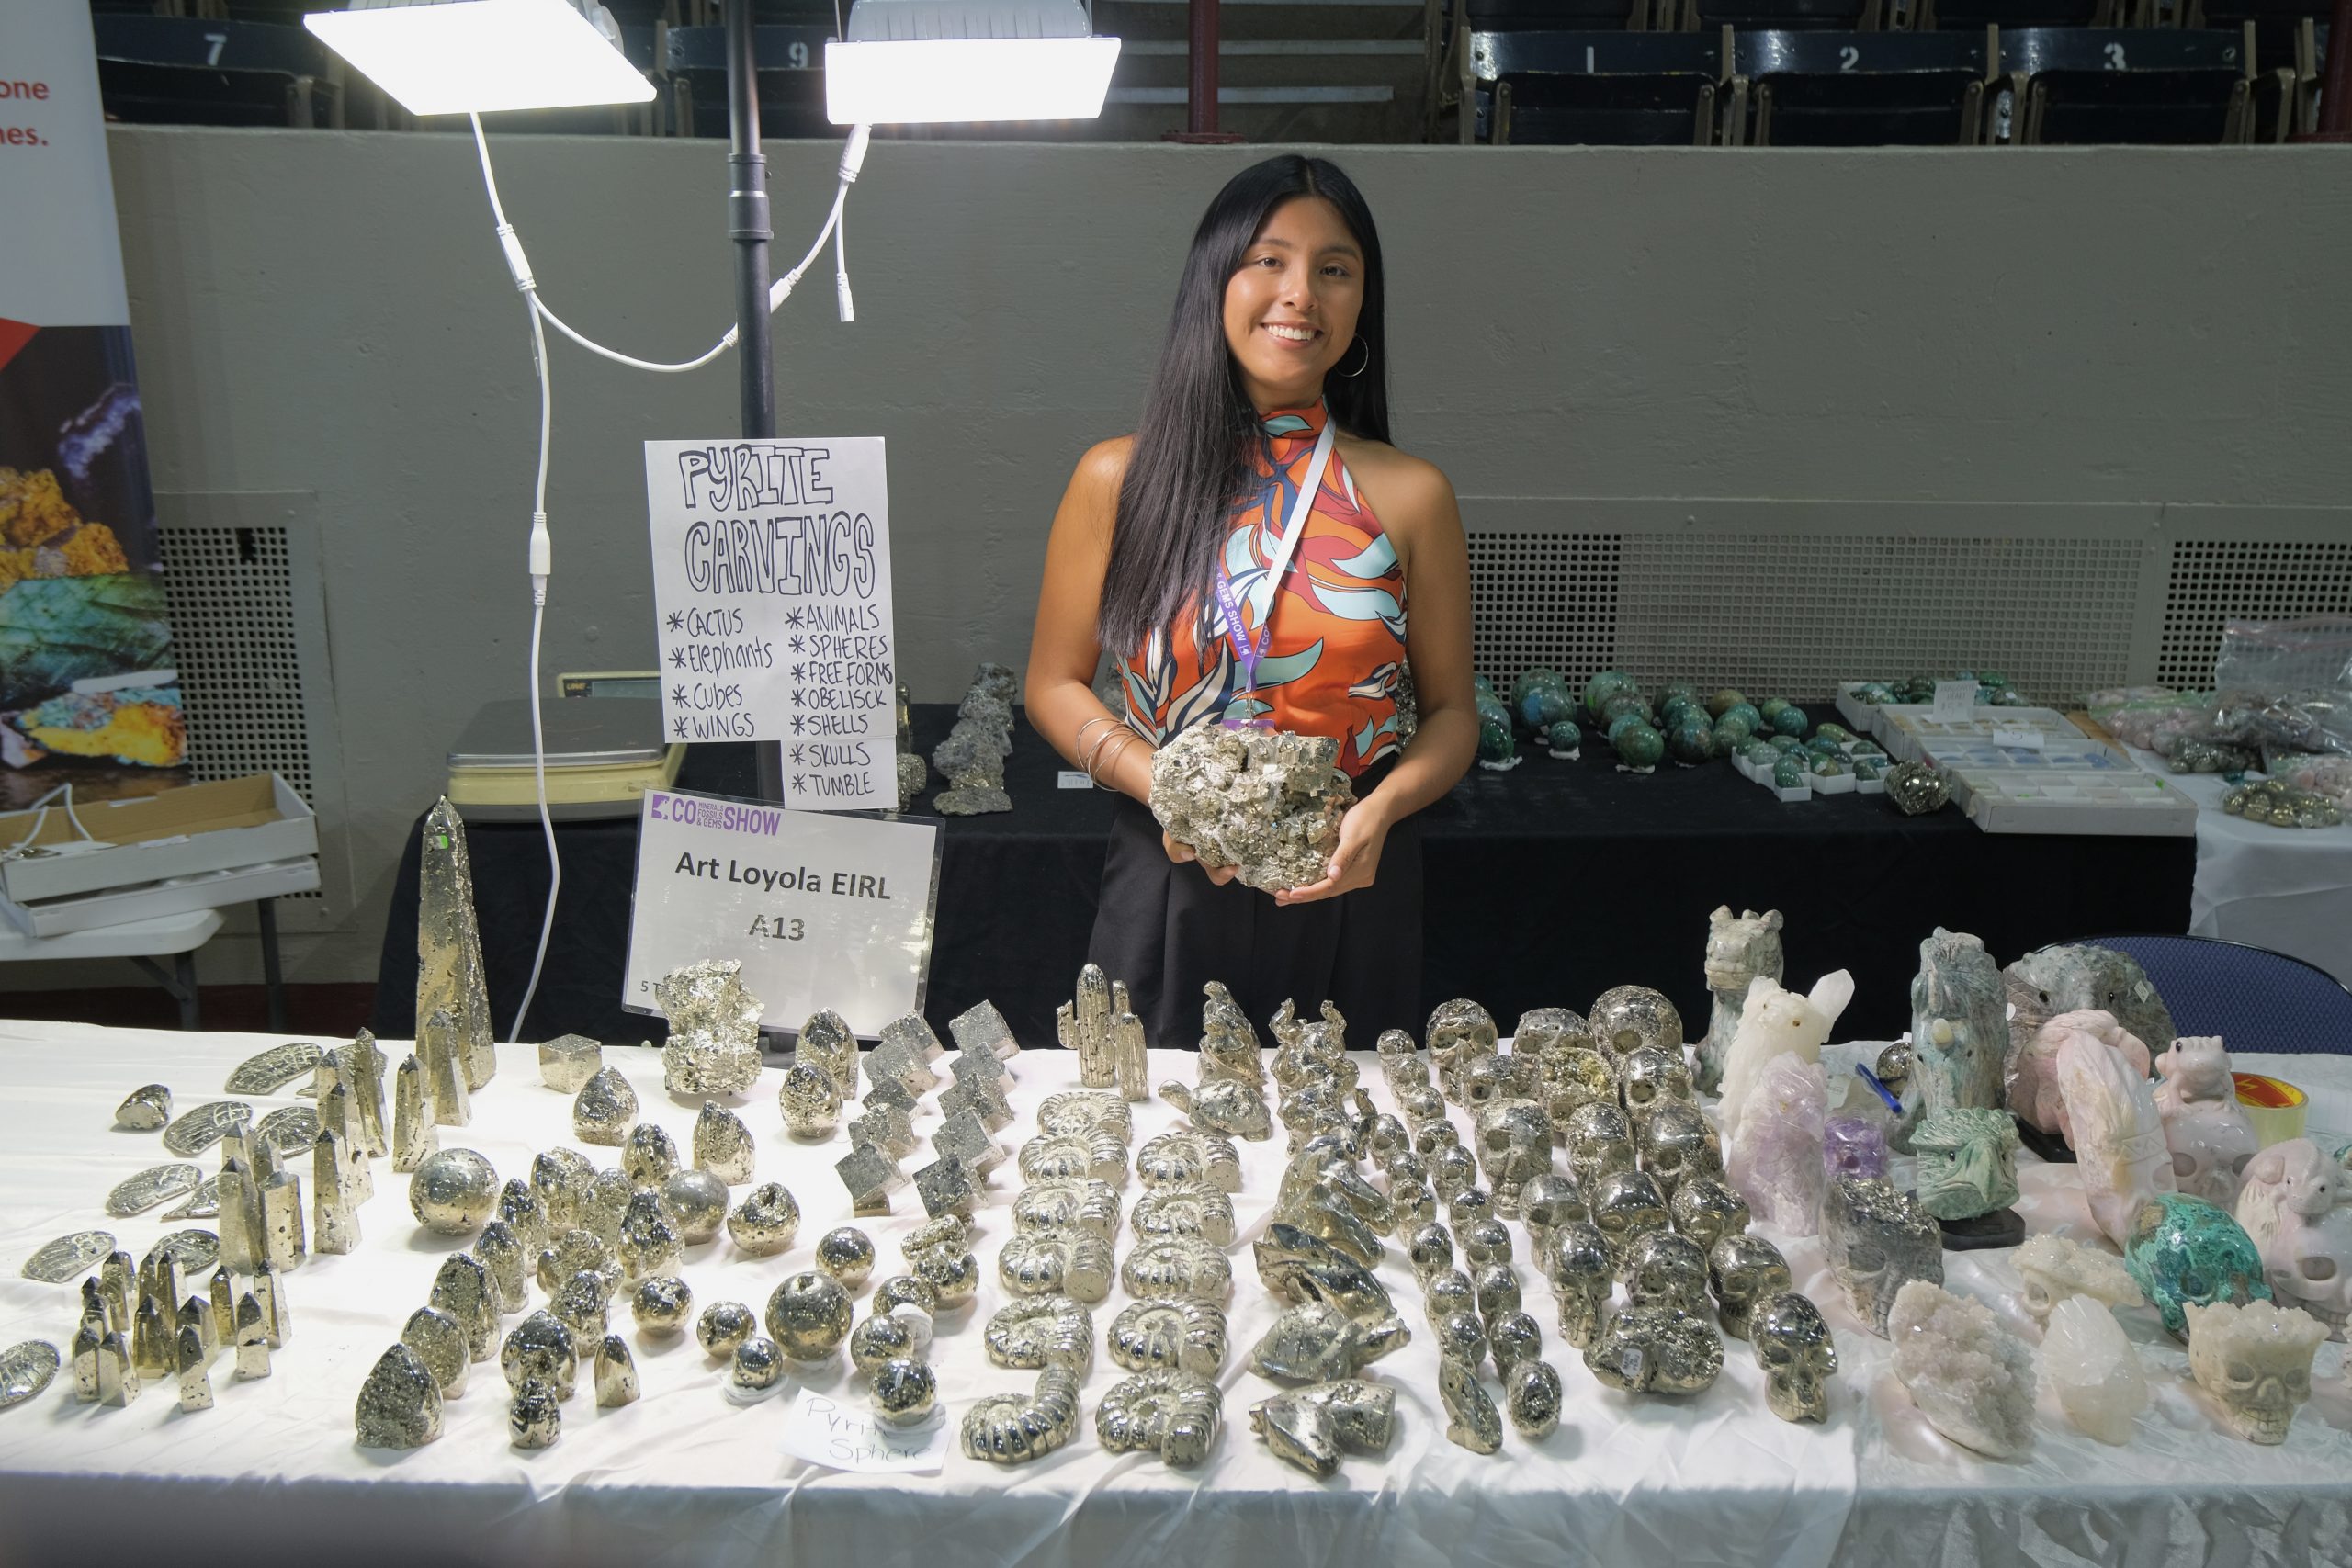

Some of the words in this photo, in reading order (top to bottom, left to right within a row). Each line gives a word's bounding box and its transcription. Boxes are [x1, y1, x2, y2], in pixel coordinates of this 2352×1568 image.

[204, 33, 228, 66] 7
[788, 41, 809, 69] 9
[1586, 46, 1595, 74] 1
[1840, 45, 1860, 73] 2
[2104, 42, 2127, 71] 3
[679, 443, 833, 512] PYRITE
[684, 511, 876, 599] CARVINGS
[687, 607, 743, 637] CACTUS
[806, 604, 881, 633] ANIMALS
[1217, 581, 1234, 609] GEMS
[1228, 610, 1247, 642] SHOW
[688, 636, 773, 678] Elephants
[809, 635, 888, 660] SPHERES
[808, 688, 888, 711] OBELISCK
[692, 712, 755, 739] WINGS
[807, 714, 868, 736] SHELLS
[808, 741, 872, 767] SKULLS
[809, 772, 875, 797] TUMBLE
[672, 797, 697, 825] CO
[697, 808, 723, 820] FOSSILS
[698, 801, 724, 812] MINERALS
[696, 818, 702, 827] &
[703, 818, 723, 829] GEMS
[723, 806, 782, 837] SHOW
[674, 852, 720, 880] Art
[729, 859, 822, 893] Loyola
[831, 872, 892, 900] EIRL
[748, 913, 806, 942] A13
[640, 980, 649, 992] 5
[829, 1438, 932, 1464] Sphere
